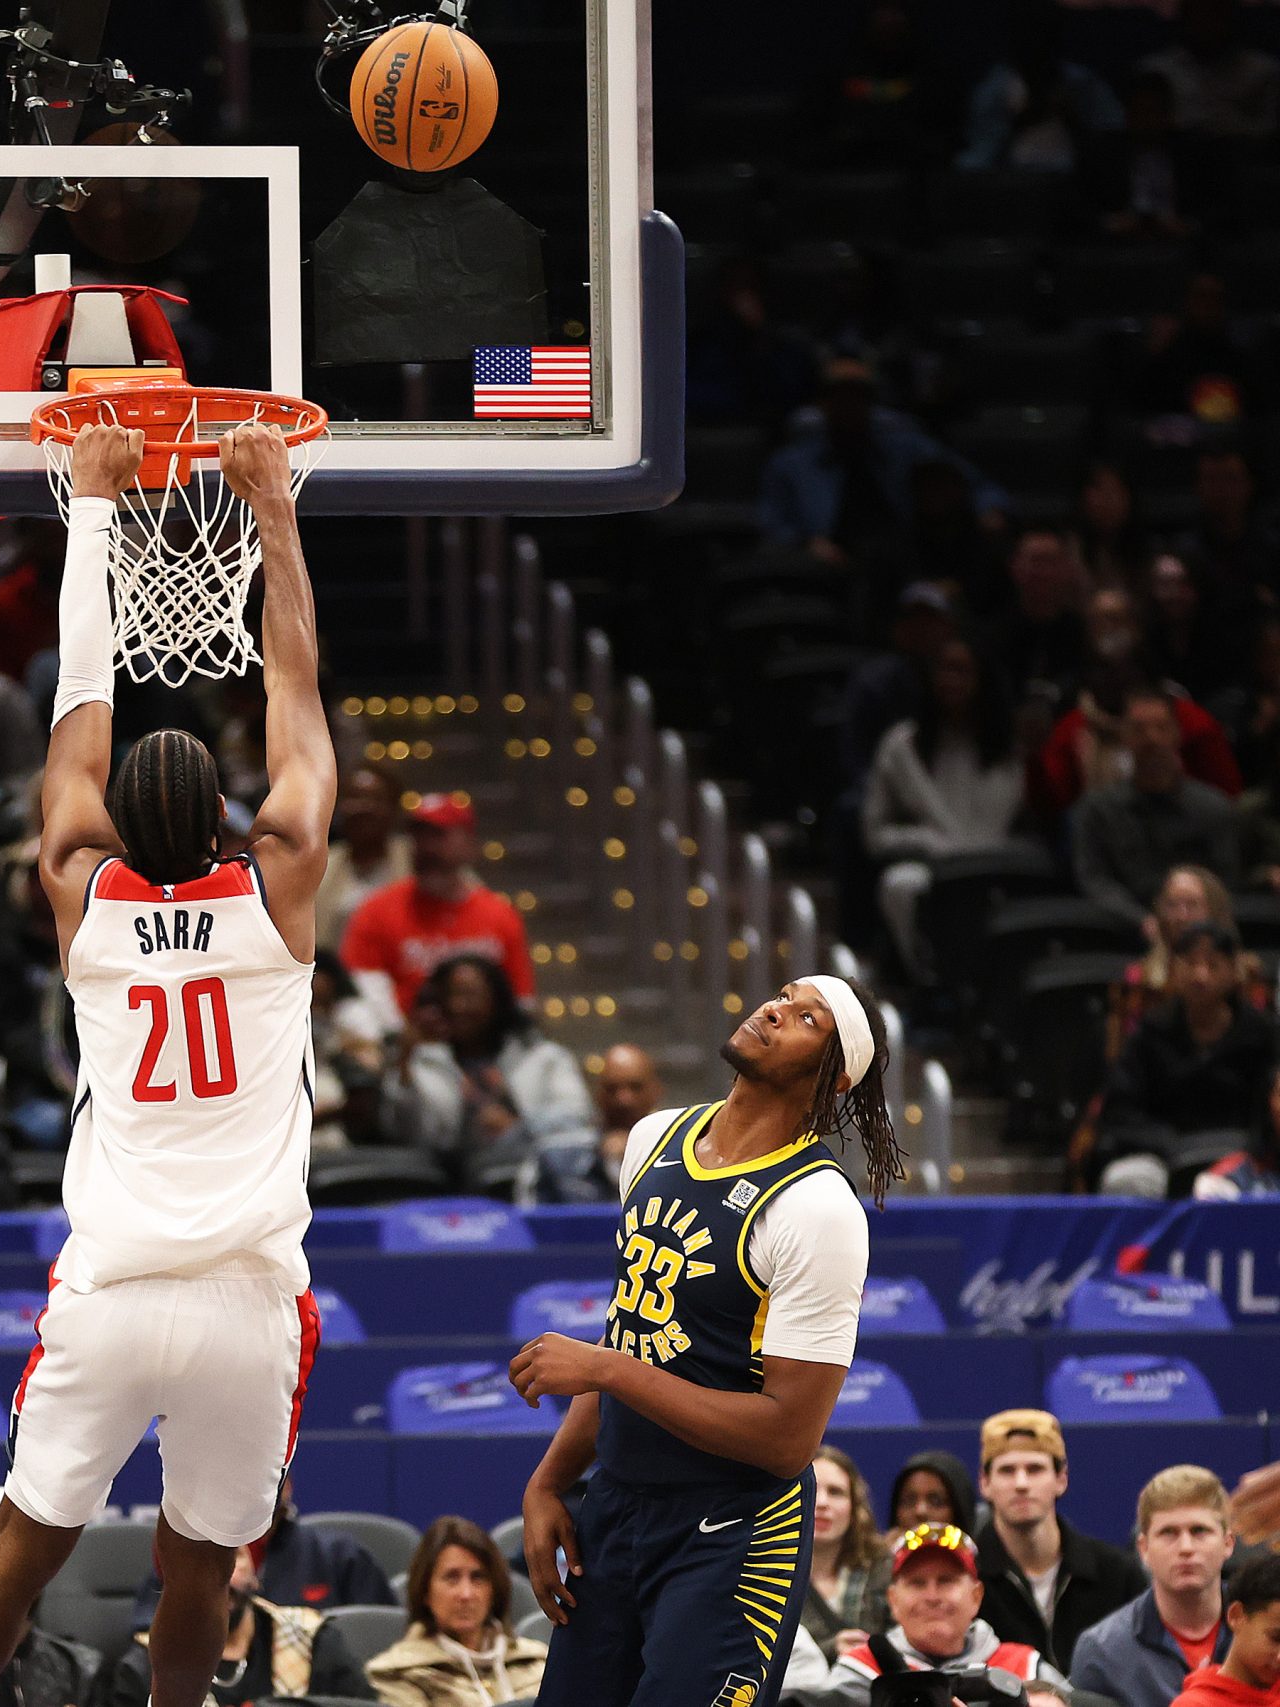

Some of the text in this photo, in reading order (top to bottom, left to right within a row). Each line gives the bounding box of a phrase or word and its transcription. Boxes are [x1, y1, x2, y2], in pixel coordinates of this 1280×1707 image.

[373, 52, 411, 145] Wilson
[133, 908, 215, 956] SARR
[127, 975, 239, 1104] 20
[615, 1196, 717, 1281] INDIANA
[615, 1233, 686, 1327] 33
